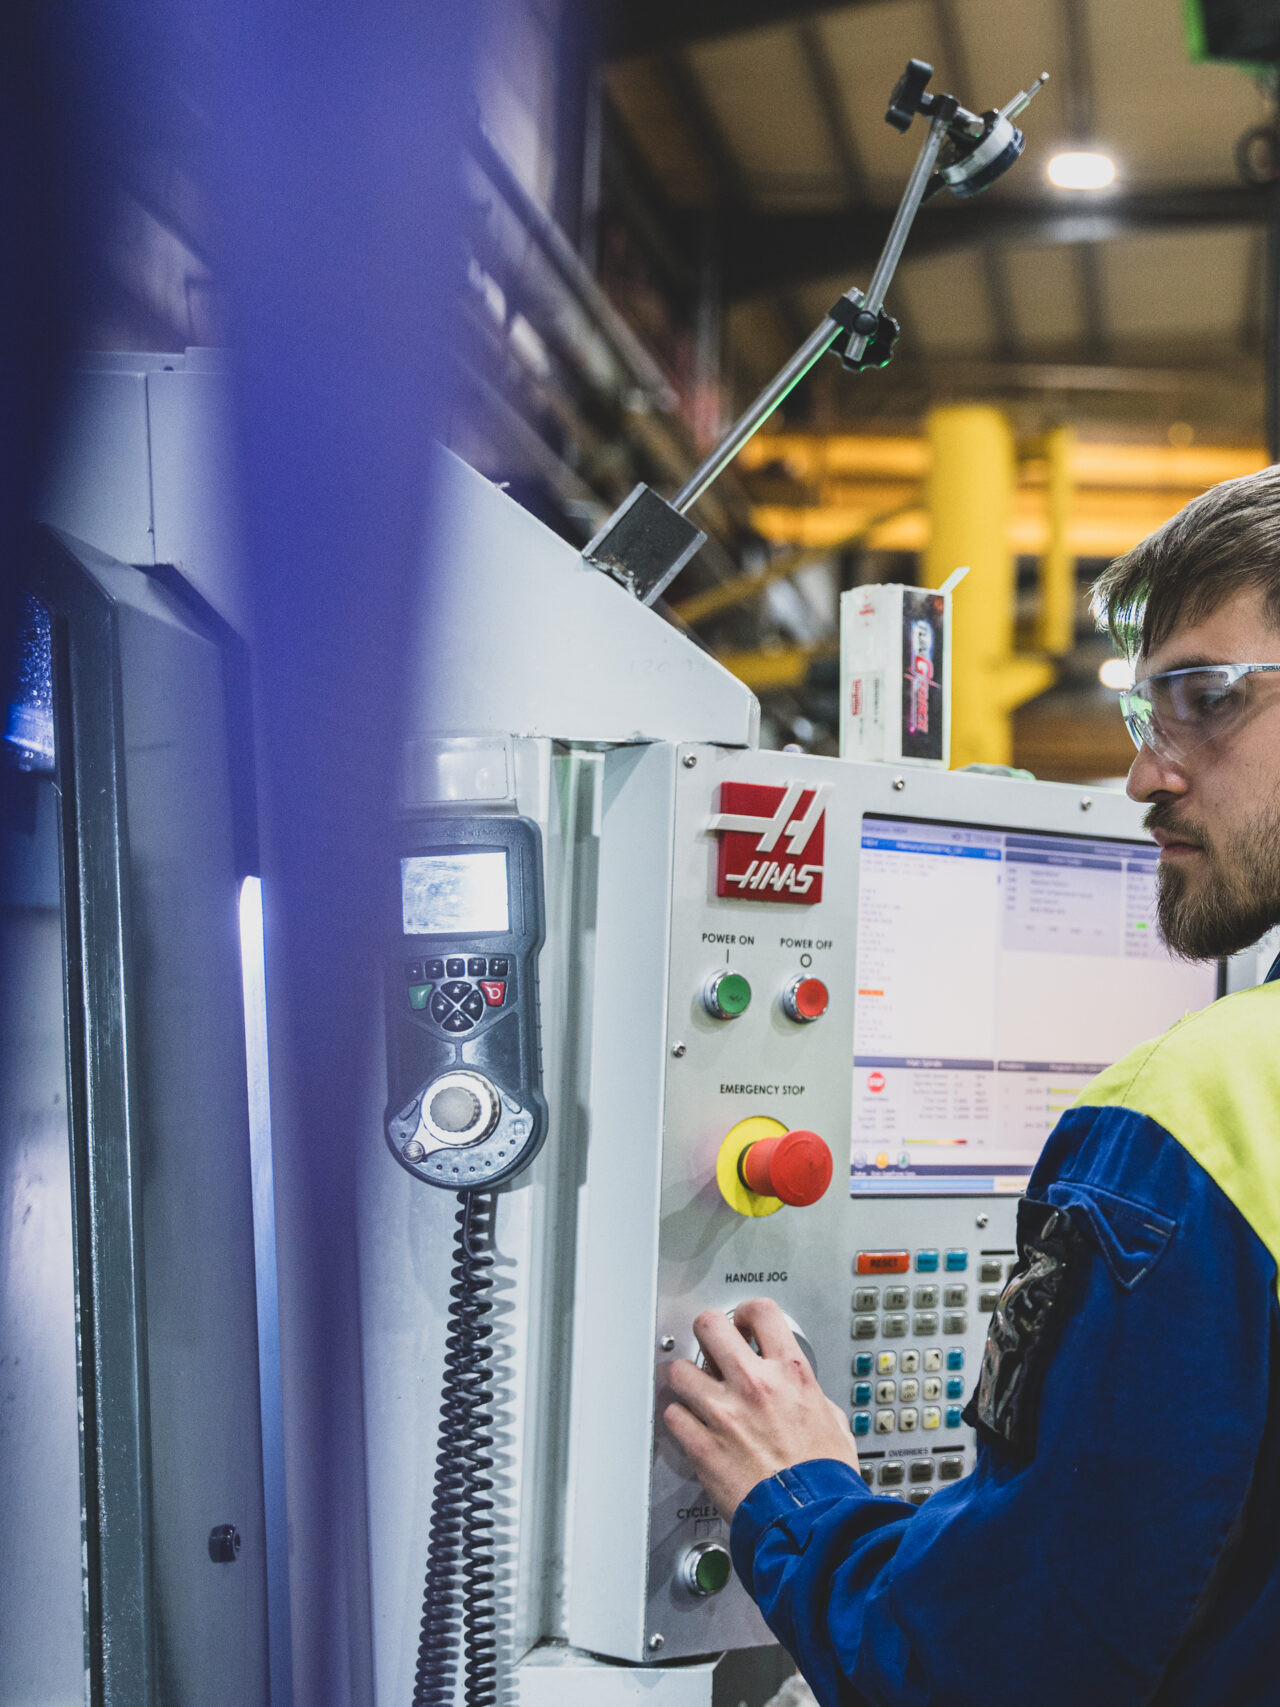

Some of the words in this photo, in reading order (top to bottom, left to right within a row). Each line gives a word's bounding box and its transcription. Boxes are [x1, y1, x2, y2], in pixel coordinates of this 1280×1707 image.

[726, 860, 824, 894] HAAS
[702, 933, 736, 944] POWER
[739, 935, 754, 945] ON
[780, 938, 813, 949] POWER
[816, 940, 833, 950] OFF
[720, 1084, 779, 1095] EMERGENCY
[782, 1085, 805, 1095] STOP
[870, 1257, 898, 1268] RESET
[725, 1272, 764, 1283] HANDLE
[767, 1271, 788, 1282] JOG
[863, 1295, 873, 1304] F1
[922, 1293, 933, 1302] F3
[676, 1506, 711, 1519] CYCLE
